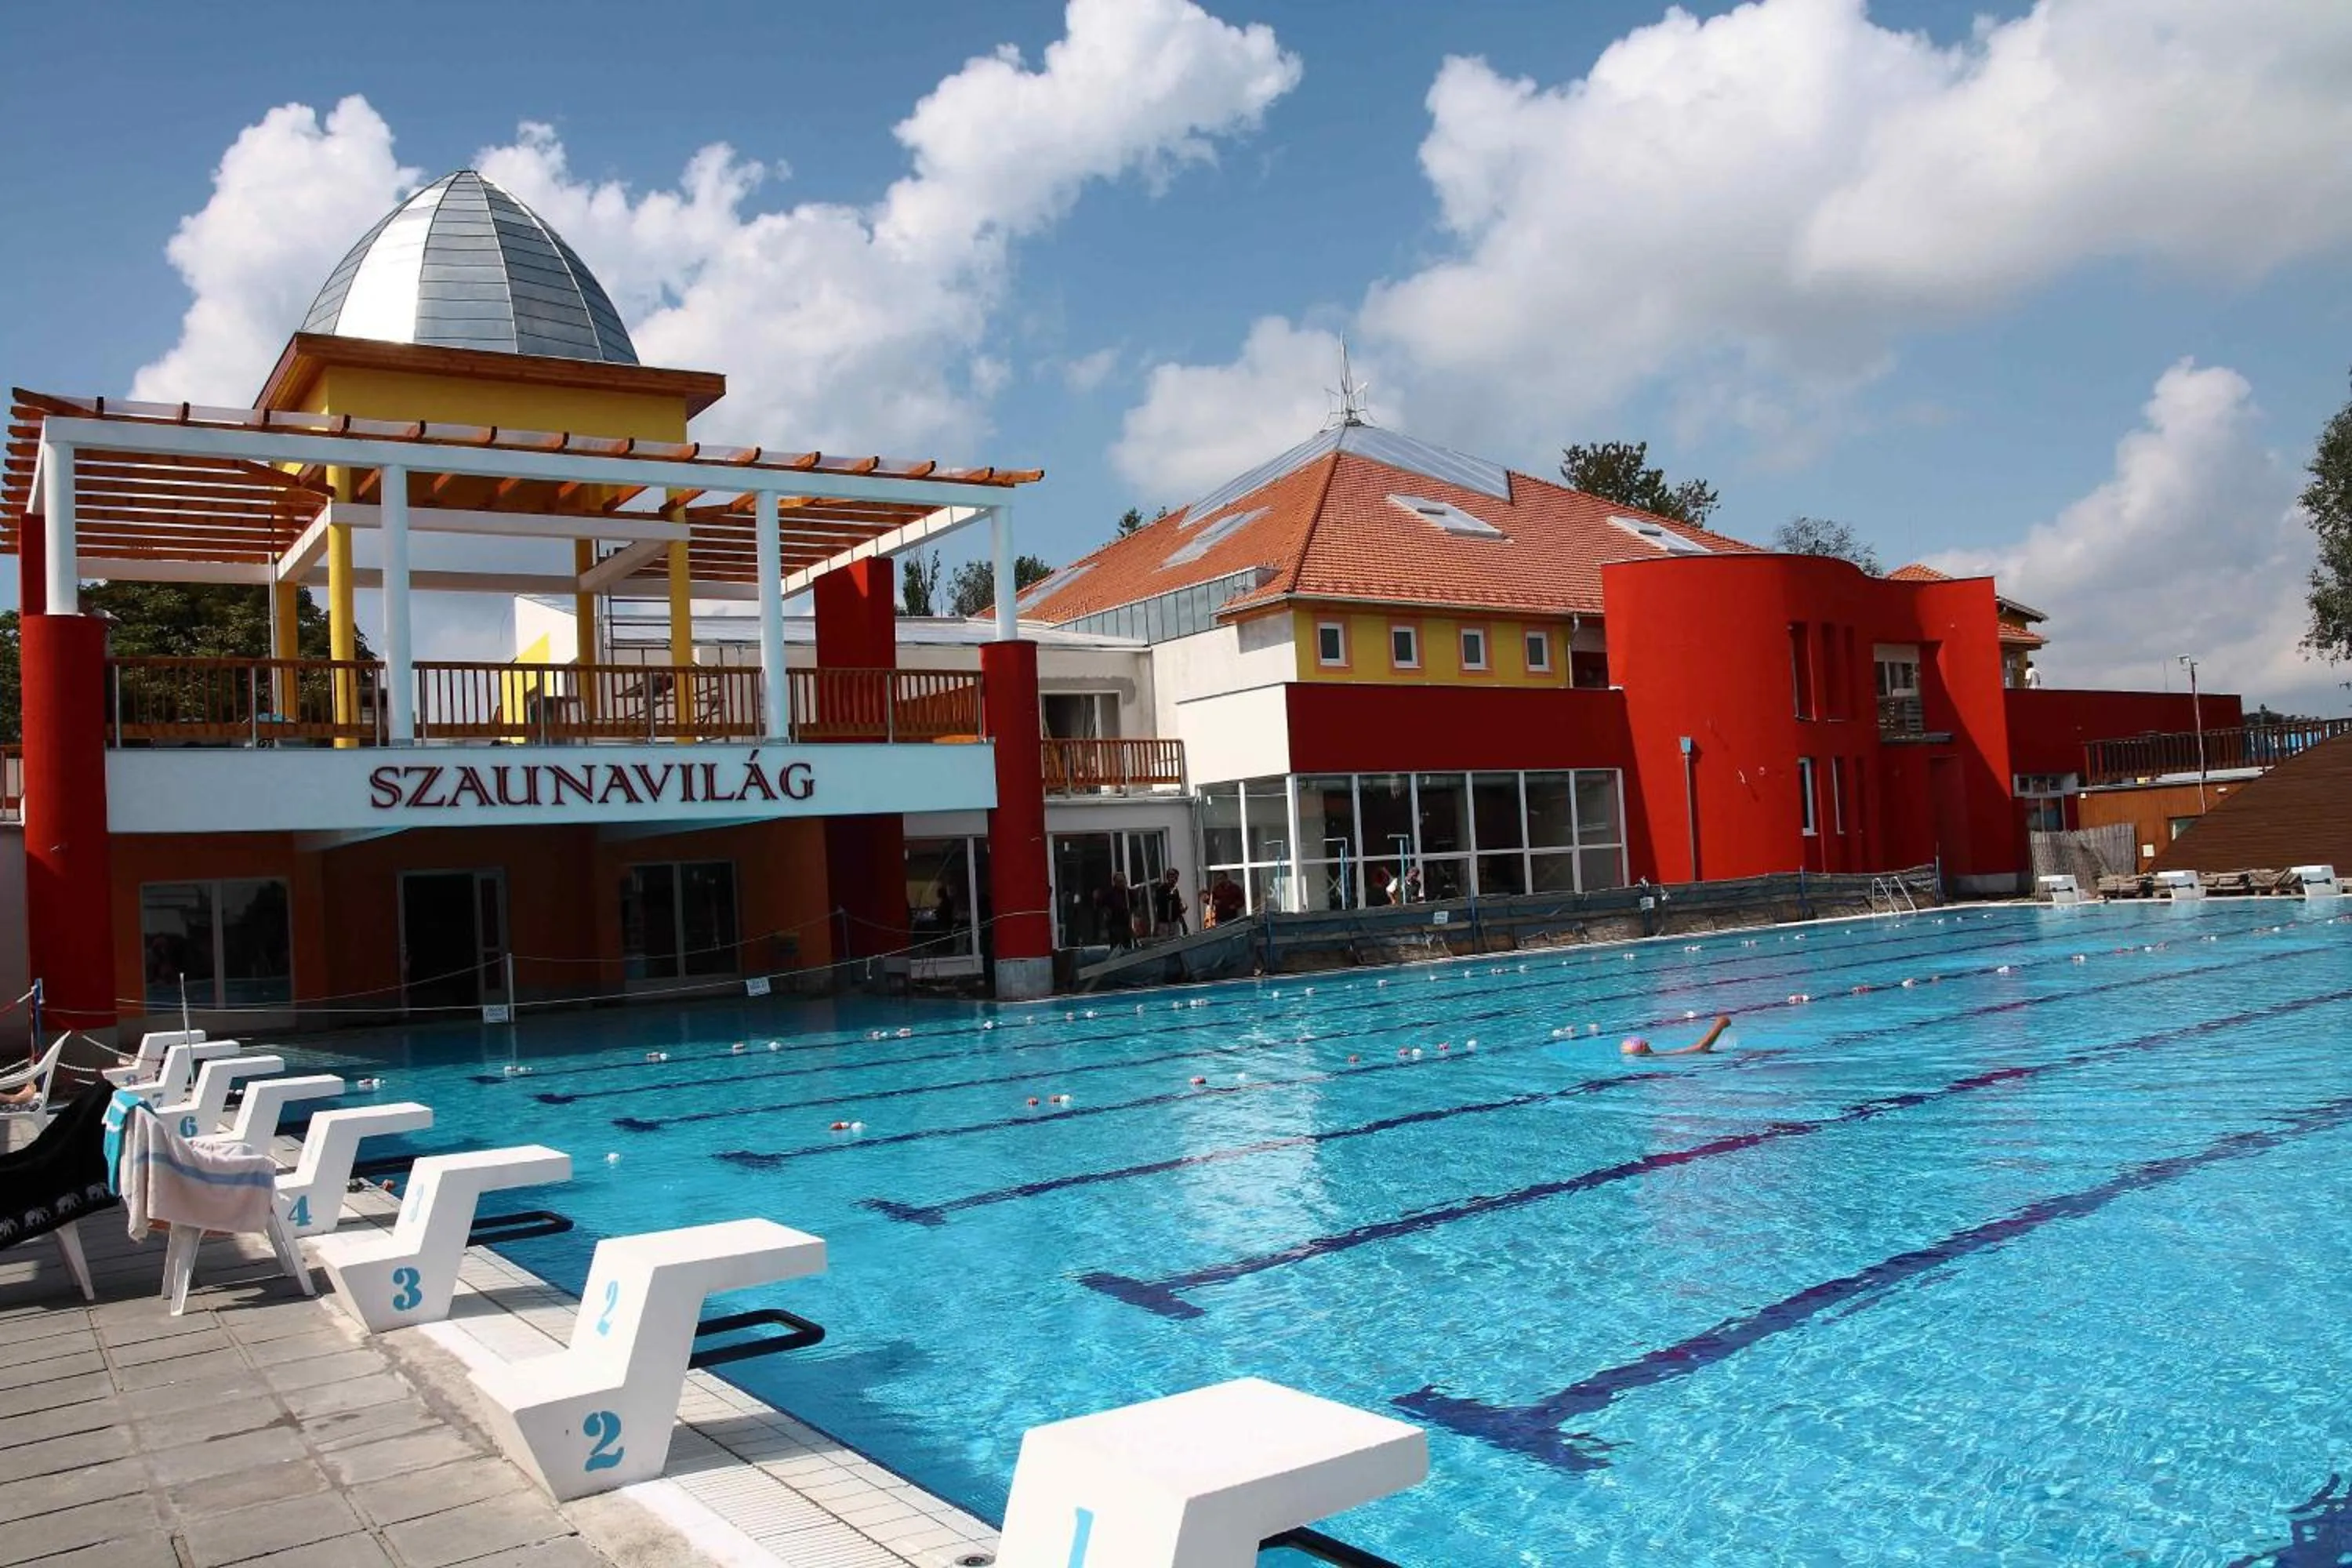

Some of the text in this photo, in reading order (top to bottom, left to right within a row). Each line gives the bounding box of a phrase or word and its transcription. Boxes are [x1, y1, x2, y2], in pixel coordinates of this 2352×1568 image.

[369, 750, 815, 808] SZAUNAVILÁG
[180, 1116, 198, 1138] 6
[288, 1195, 313, 1226] 4
[393, 1267, 423, 1311] 3
[597, 1280, 619, 1335] 2
[583, 1410, 625, 1472] 2
